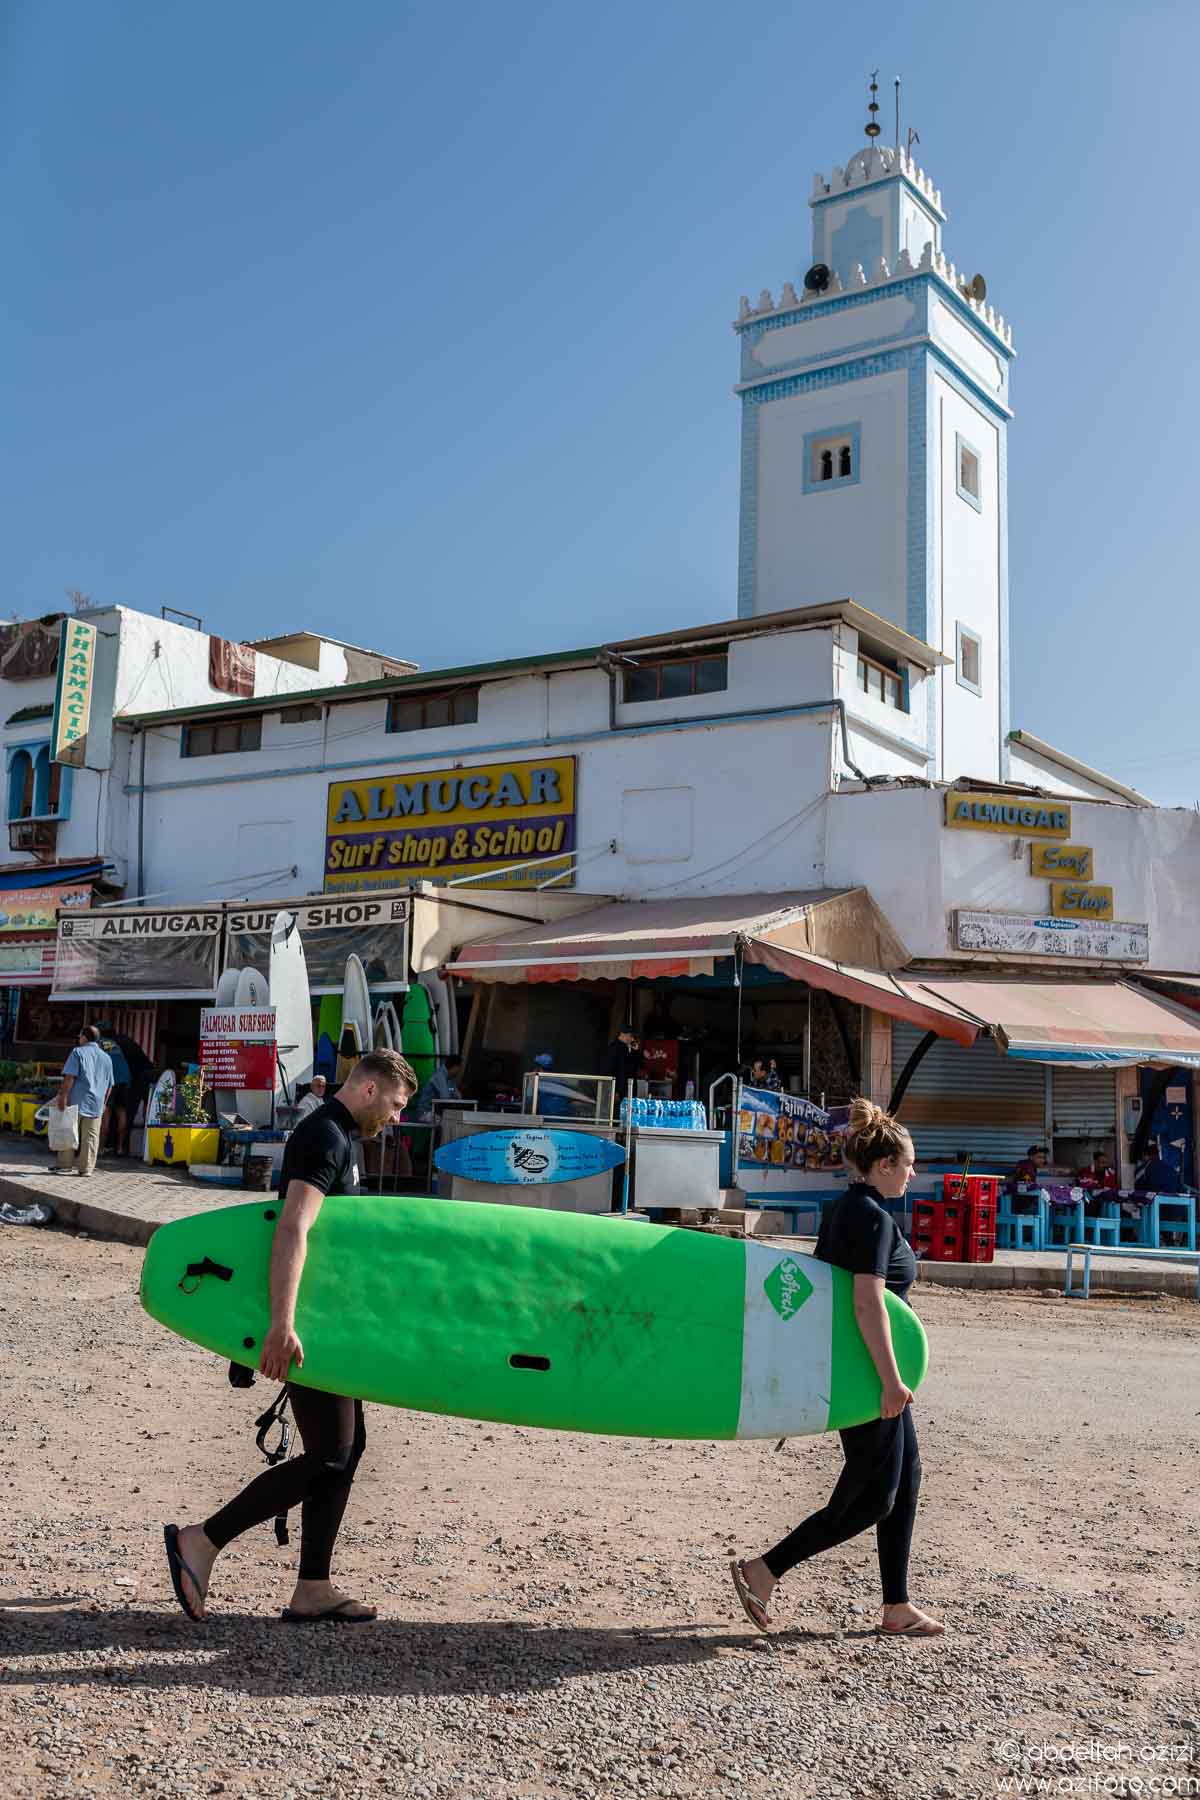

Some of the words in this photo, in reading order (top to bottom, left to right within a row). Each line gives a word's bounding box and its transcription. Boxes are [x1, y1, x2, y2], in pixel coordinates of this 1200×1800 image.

[64, 625, 90, 740] PHARMACIE
[336, 770, 561, 822] ALMUGAR
[956, 801, 1067, 829] ALMUGAR
[327, 836, 387, 870] Surf
[388, 833, 448, 868] shop
[450, 827, 469, 860] &
[472, 821, 564, 858] School
[1043, 848, 1089, 875] Surf
[1062, 888, 1109, 915] Shop
[101, 915, 218, 936] ALMUGAR
[230, 911, 299, 932] SUR
[307, 904, 382, 927] SHOP
[204, 1015, 236, 1032] ALMUGAR
[780, 1259, 801, 1319] Softech
